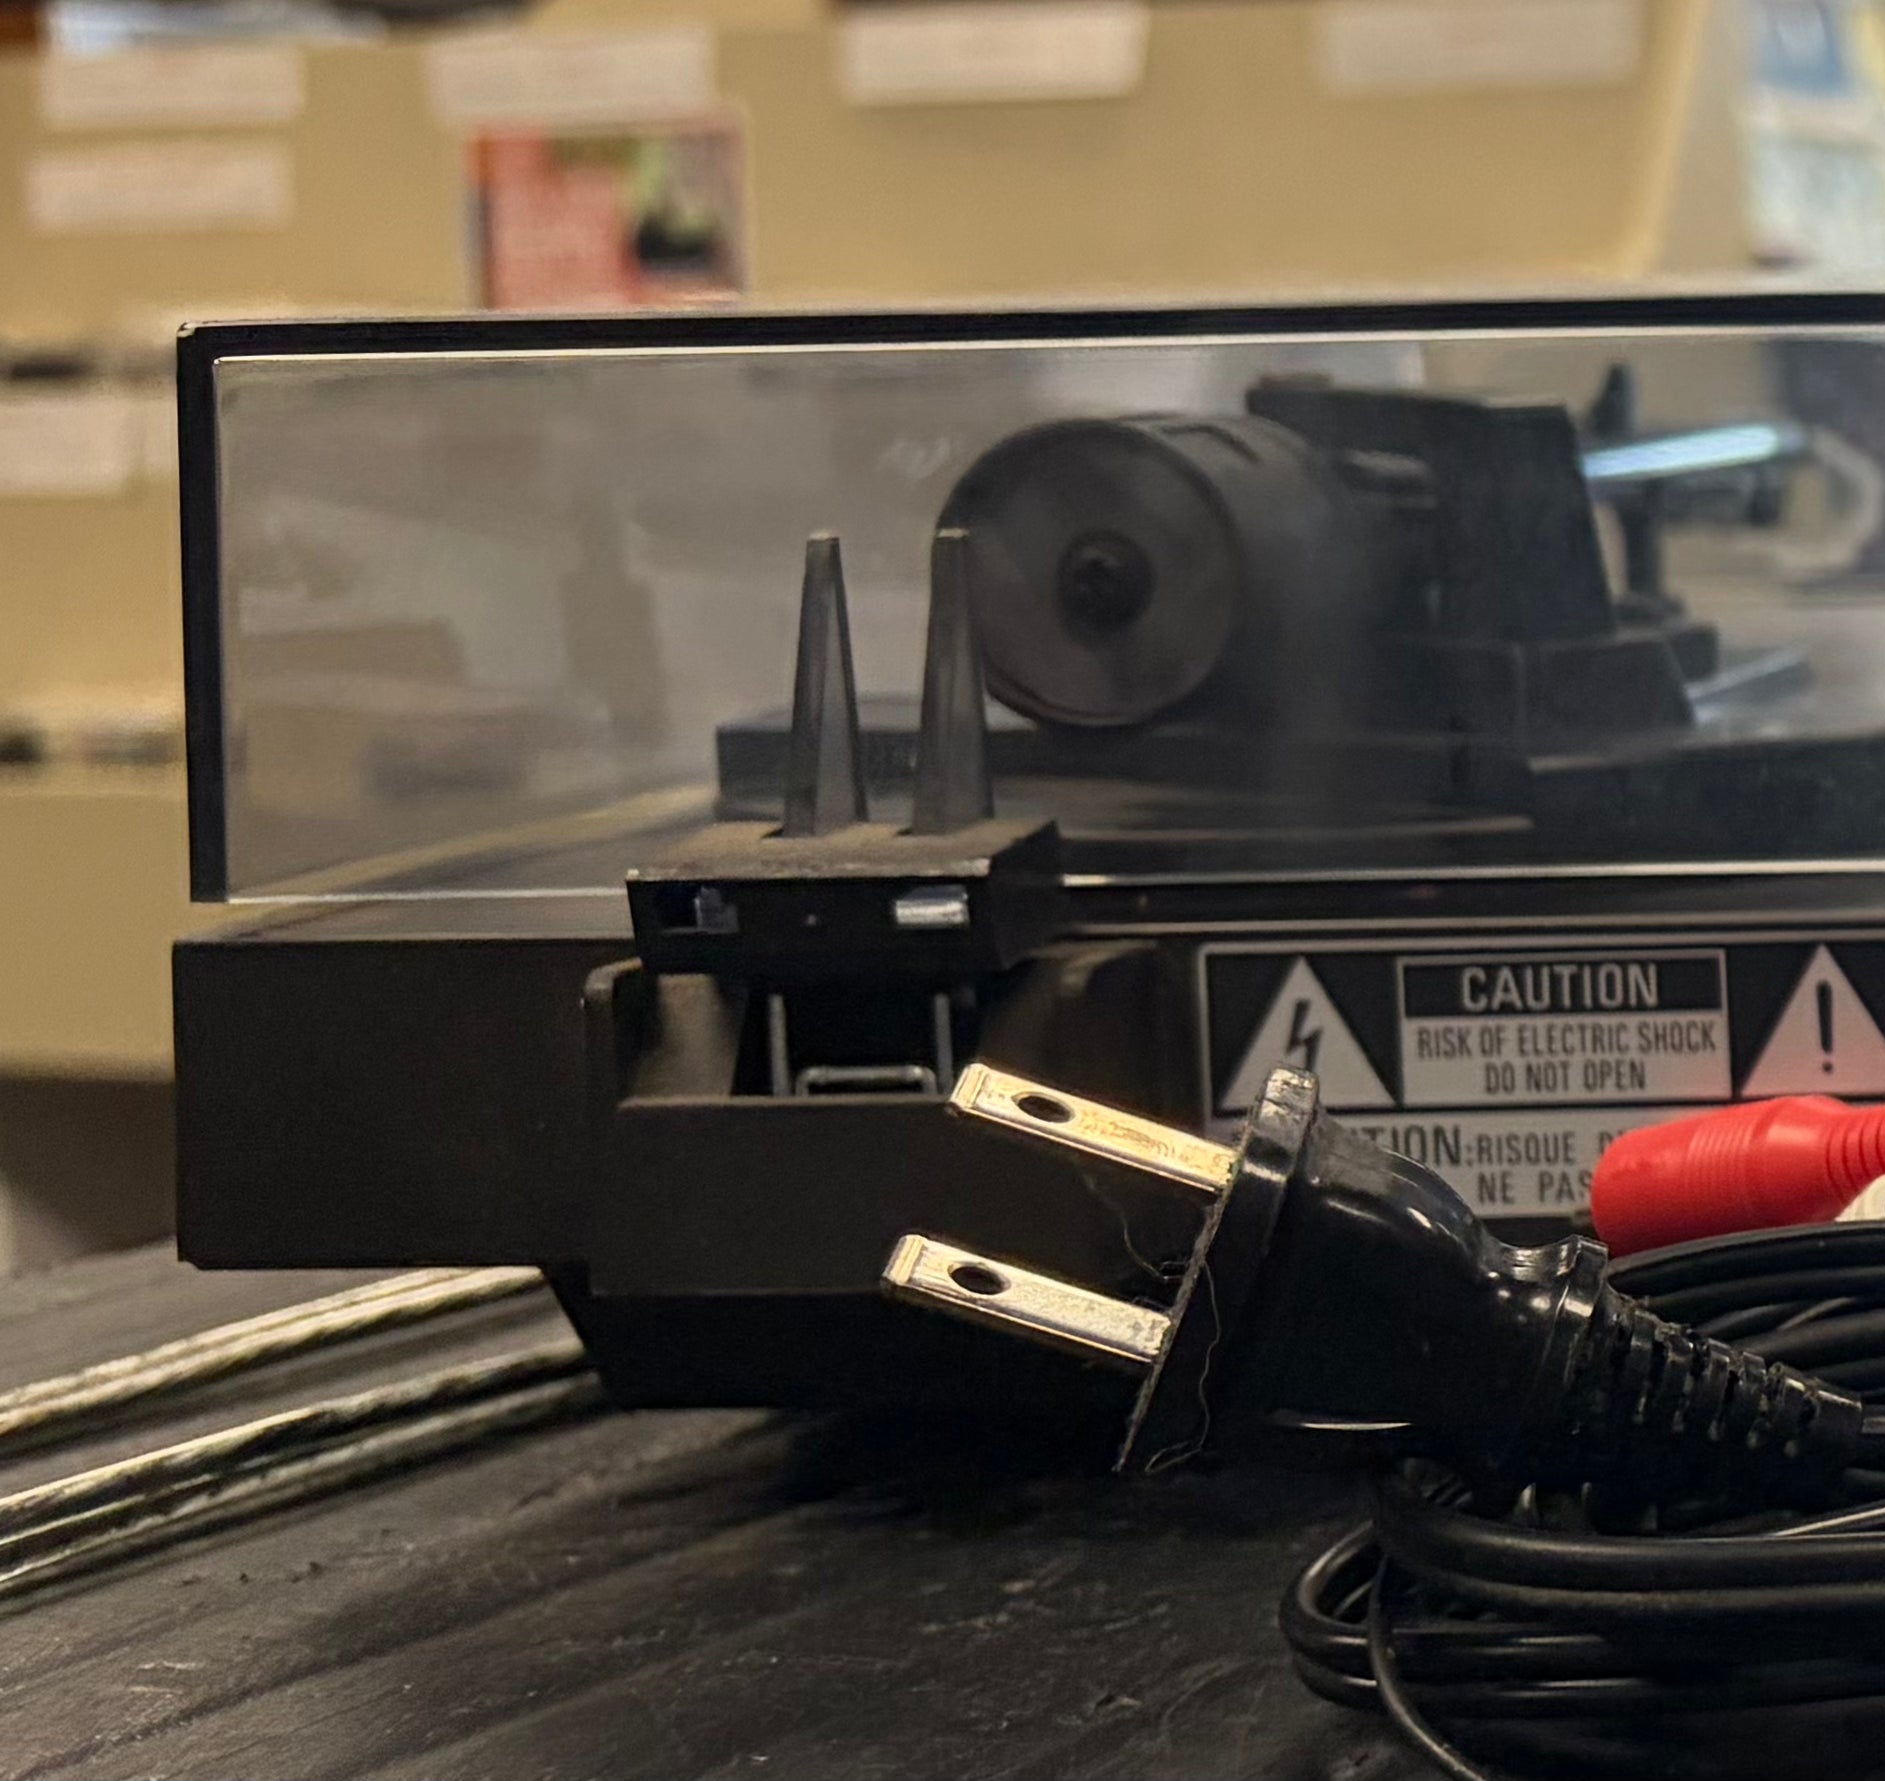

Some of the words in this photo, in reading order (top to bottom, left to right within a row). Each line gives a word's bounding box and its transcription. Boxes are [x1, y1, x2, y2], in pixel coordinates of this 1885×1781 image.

[1461, 963, 1658, 1012] CAUTION
[1417, 1026, 1472, 1060] RISK
[1479, 1024, 1506, 1056] OF
[1518, 1022, 1631, 1057] ELECTRIC
[1637, 1019, 1717, 1054] SHOCK
[1485, 1063, 1515, 1094] DO
[1526, 1061, 1571, 1093] NOT
[1583, 1059, 1646, 1091] OPEN
[1477, 1131, 1576, 1166] RISQUE
[1478, 1171, 1517, 1205] NE
